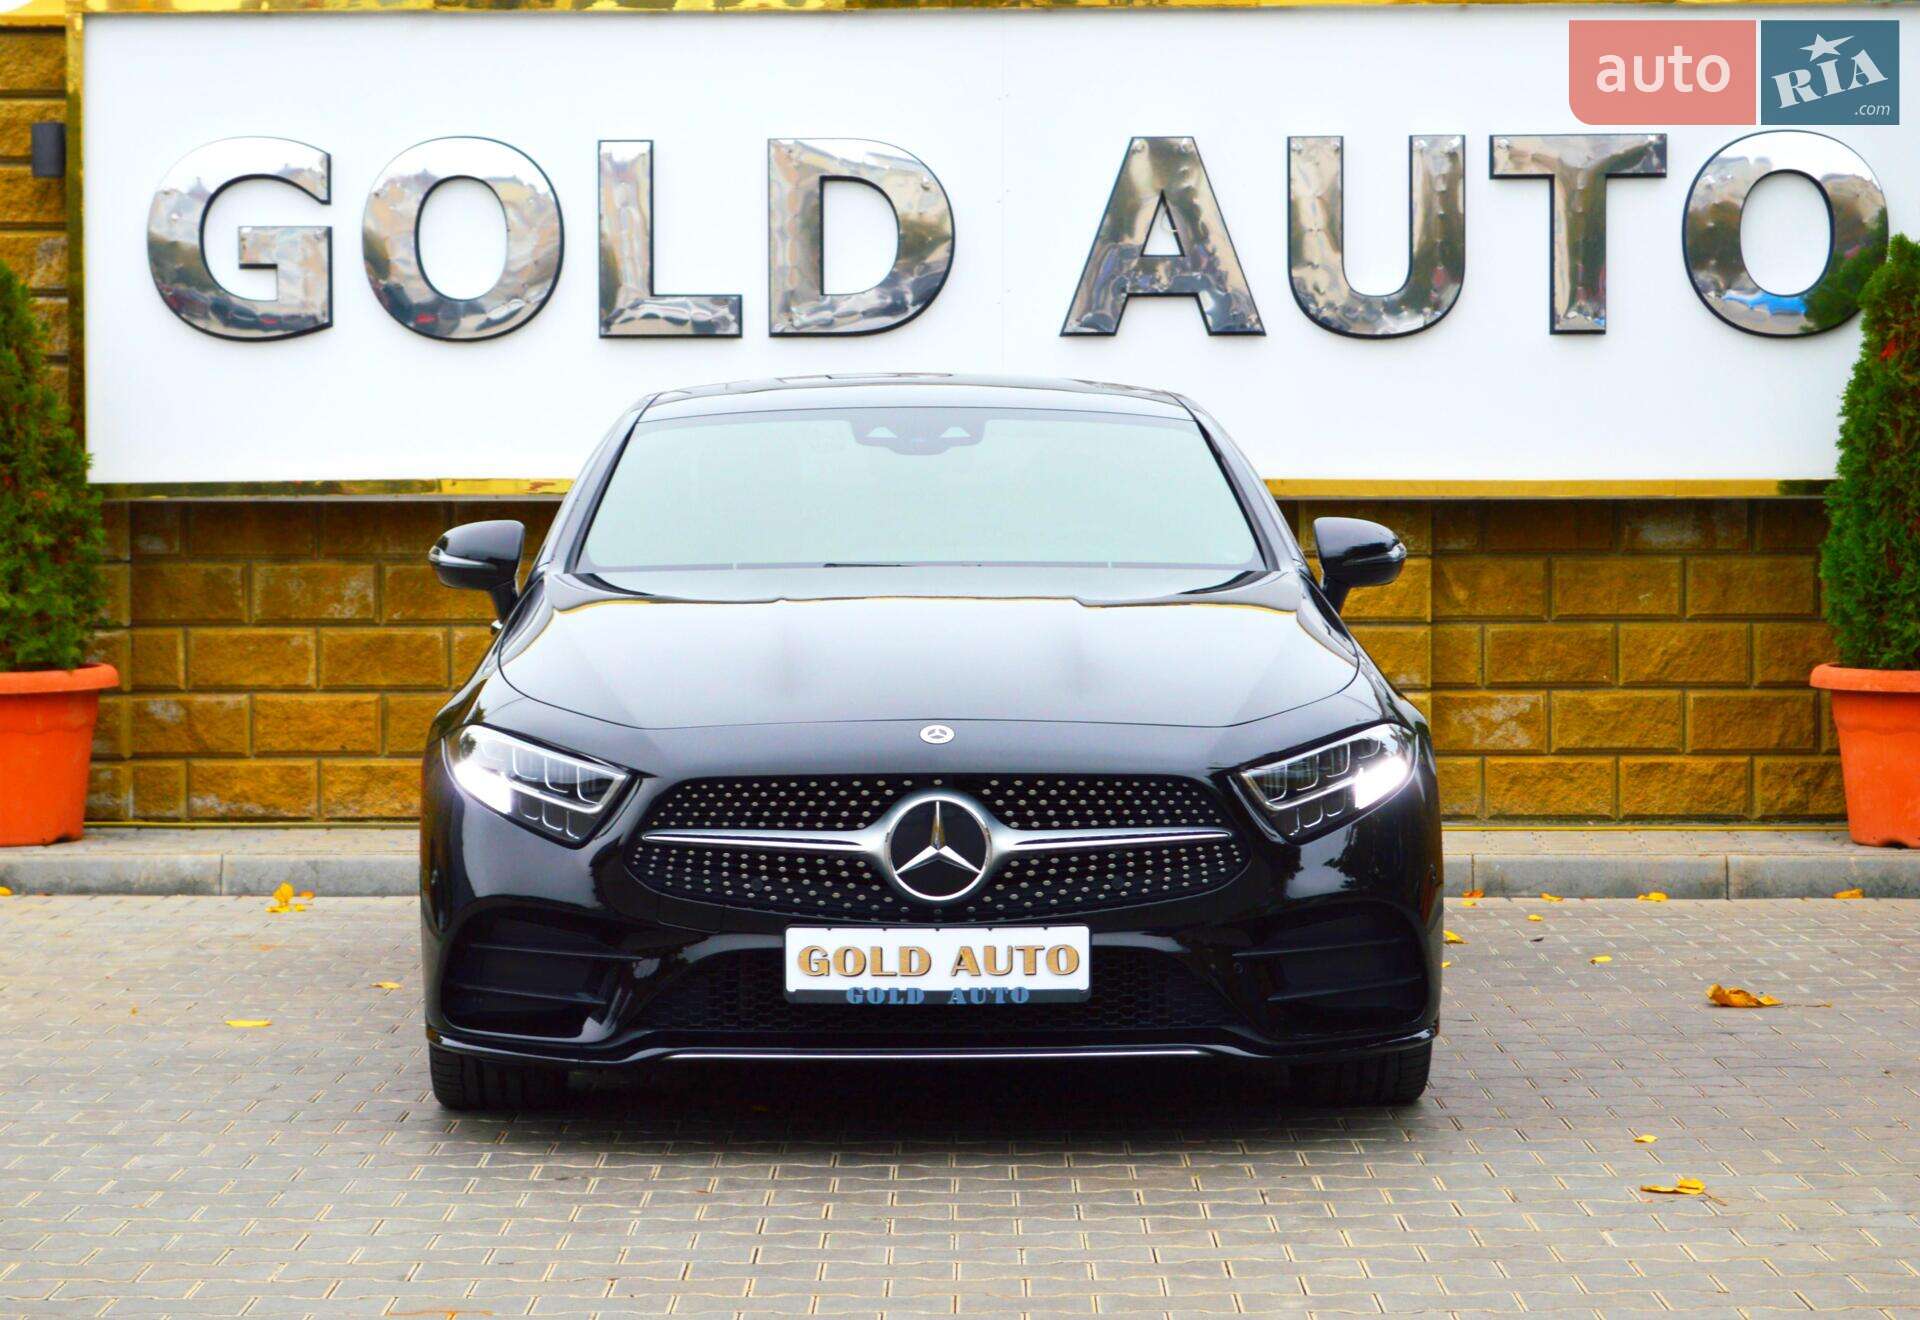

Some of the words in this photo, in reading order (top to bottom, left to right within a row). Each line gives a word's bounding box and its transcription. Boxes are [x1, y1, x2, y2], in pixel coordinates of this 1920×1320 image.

[147, 136, 956, 342] GOLD
[1059, 129, 1889, 339] AUTO
[797, 945, 932, 977] GOLD
[951, 943, 1080, 976] AUTO
[846, 986, 925, 1005] GOLD
[947, 986, 1030, 1005] AUTO
